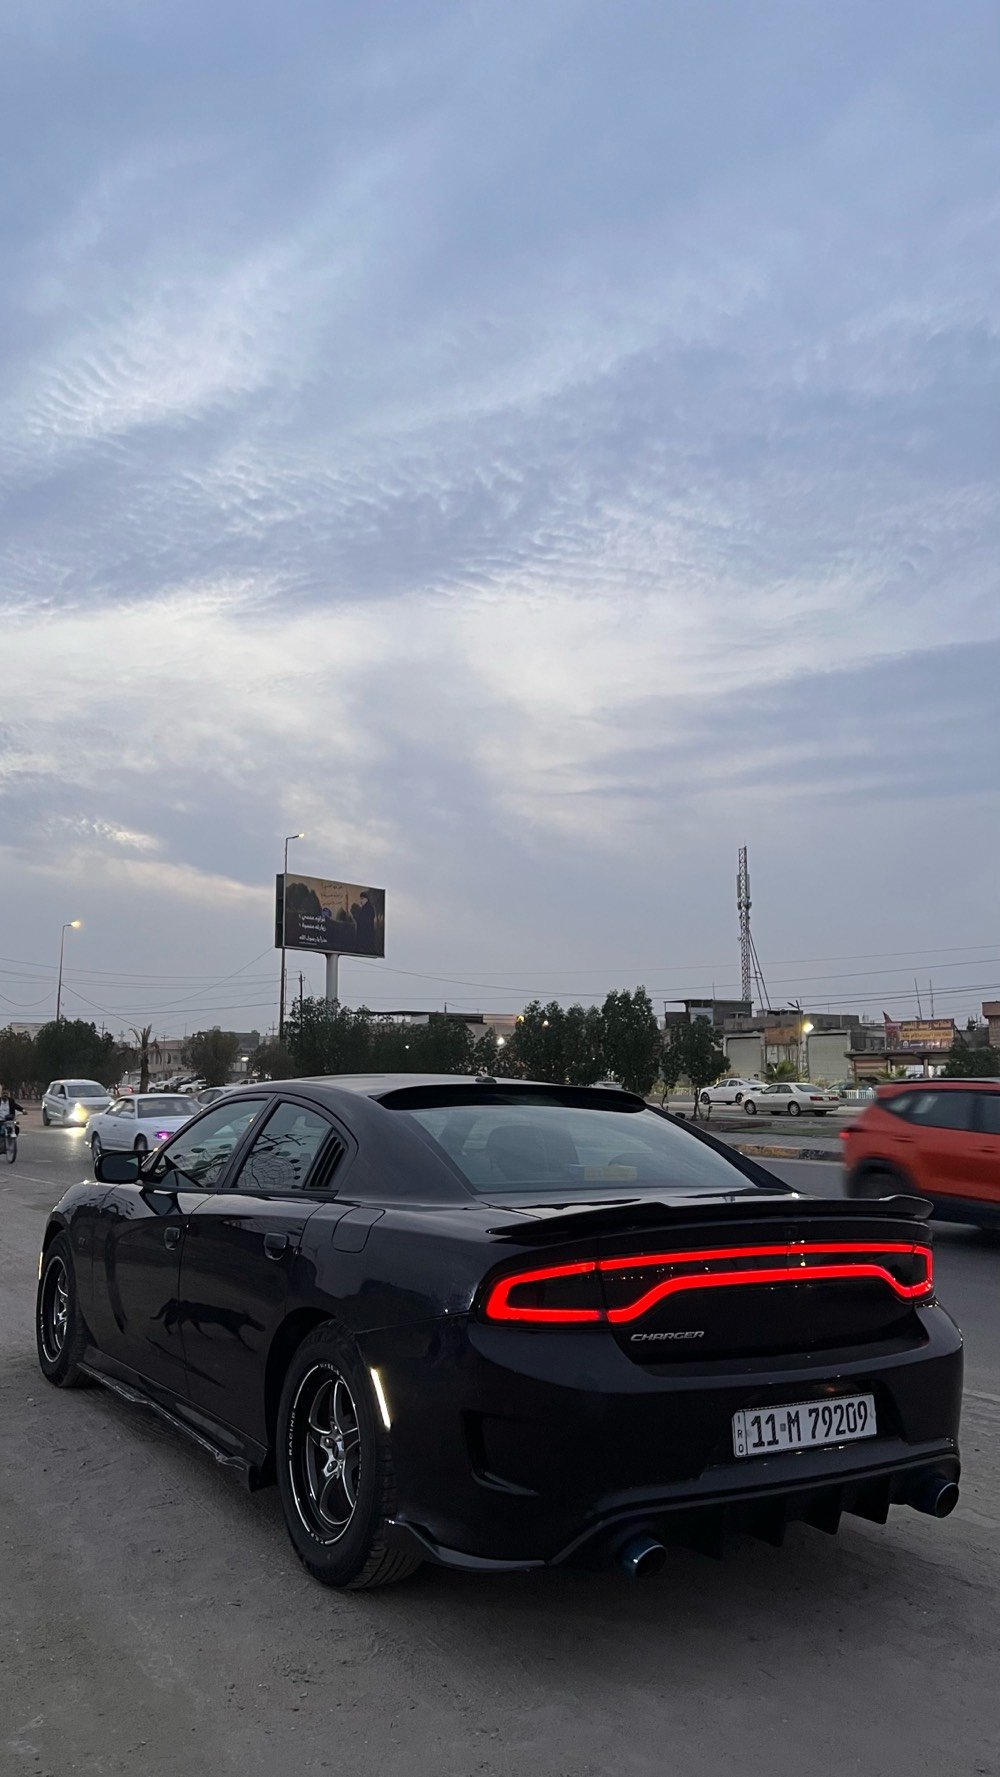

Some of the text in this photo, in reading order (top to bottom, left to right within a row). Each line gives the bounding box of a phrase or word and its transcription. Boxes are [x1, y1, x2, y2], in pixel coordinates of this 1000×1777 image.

[630, 1331, 705, 1341] CHARGER
[751, 1400, 868, 1448] 11 M 79209
